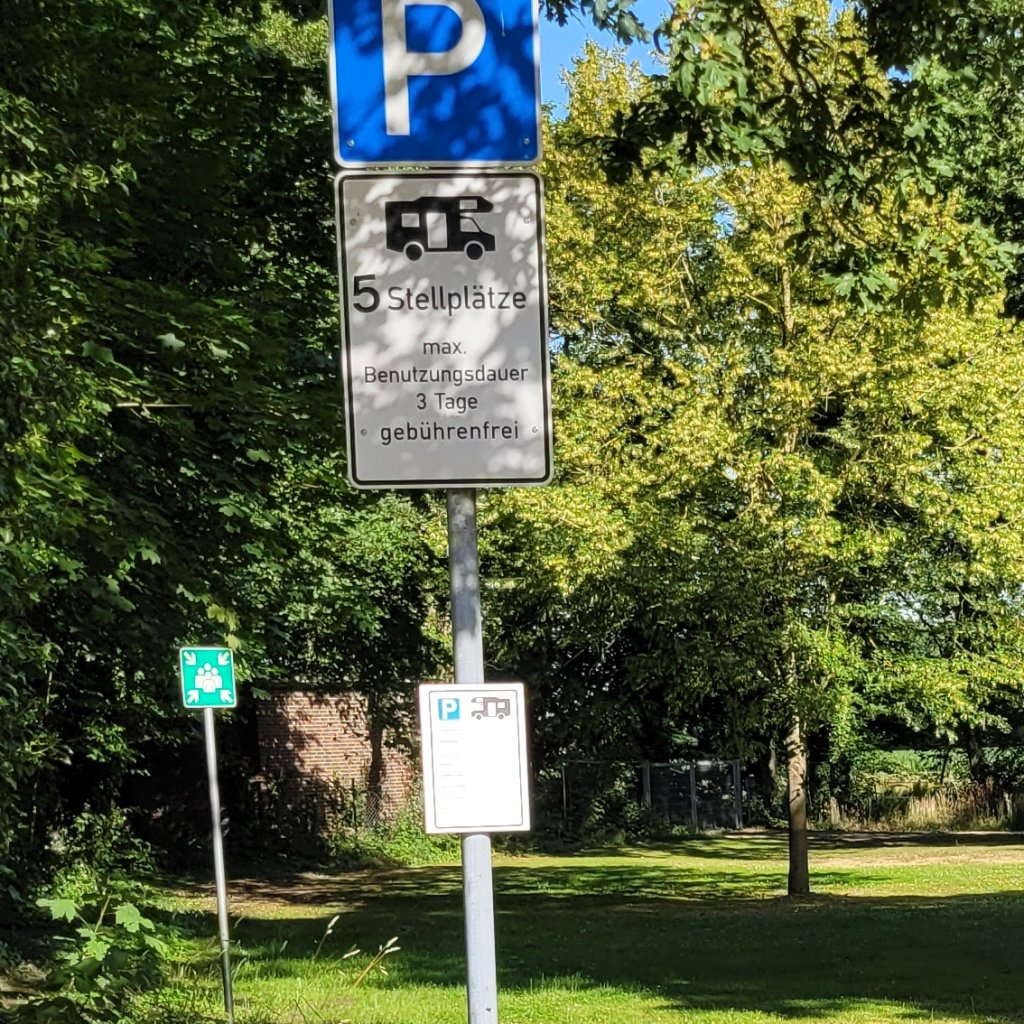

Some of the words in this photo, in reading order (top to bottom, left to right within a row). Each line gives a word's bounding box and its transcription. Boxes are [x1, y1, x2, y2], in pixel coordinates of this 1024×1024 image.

[382, 0, 487, 136] P
[353, 274, 380, 313] 5
[388, 285, 527, 316] Stellplätze
[423, 341, 467, 355] max.
[364, 365, 529, 387] Benutzungsdauer
[416, 392, 427, 411] 3
[434, 392, 478, 414] Tage
[380, 421, 519, 445] gebührenfrei
[442, 698, 458, 721] P
